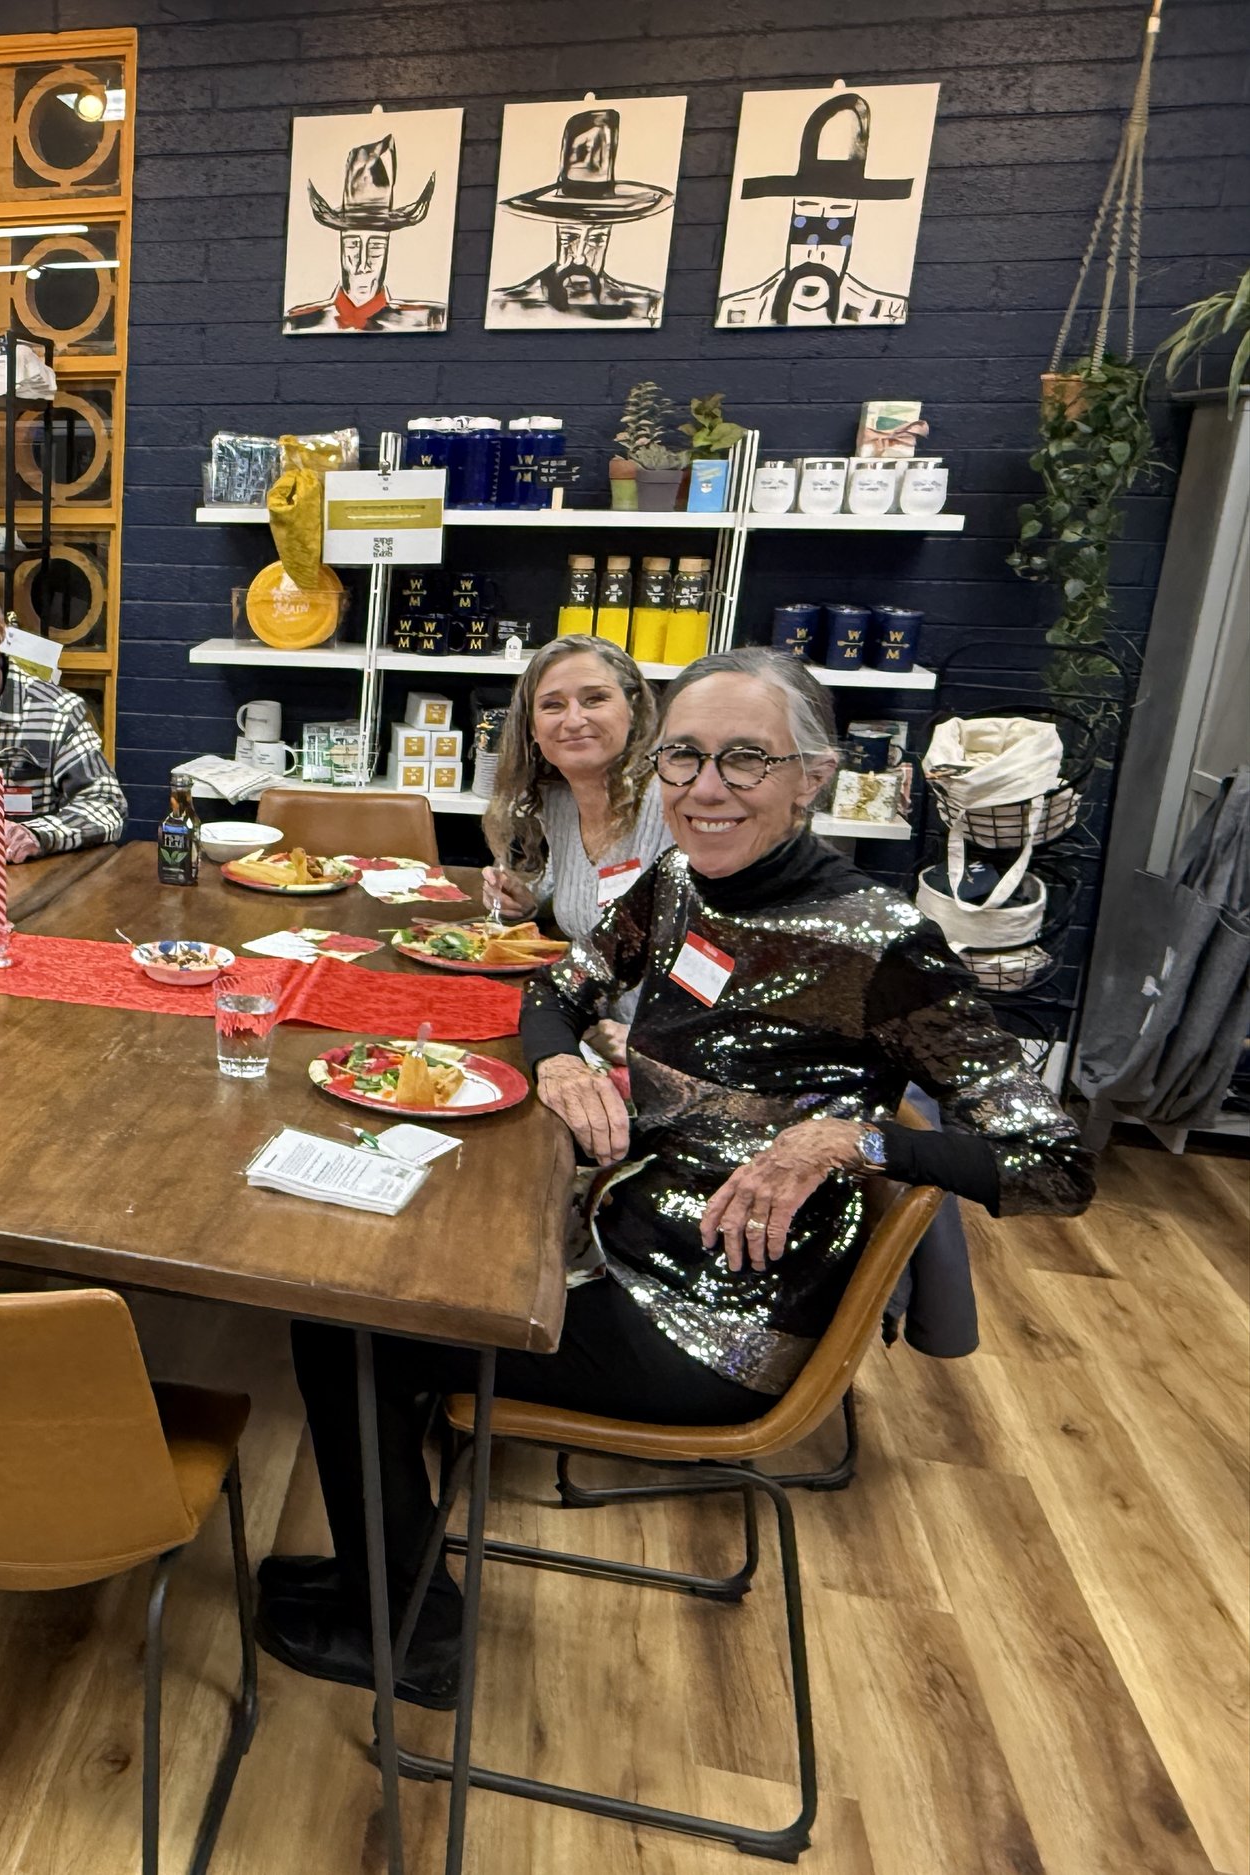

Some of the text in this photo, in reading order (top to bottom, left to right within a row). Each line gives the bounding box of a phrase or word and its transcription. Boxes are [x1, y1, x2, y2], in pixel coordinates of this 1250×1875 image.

[410, 579, 423, 589] W
[460, 580, 473, 590] W
[459, 597, 471, 607] M
[400, 620, 412, 631] W
[424, 621, 437, 632] W
[471, 621, 484, 632] W
[848, 630, 861, 640] W
[889, 631, 904, 642] W
[398, 637, 410, 648] M
[423, 639, 435, 649] M
[470, 639, 482, 649] M
[844, 648, 858, 657] M
[886, 649, 900, 659] M
